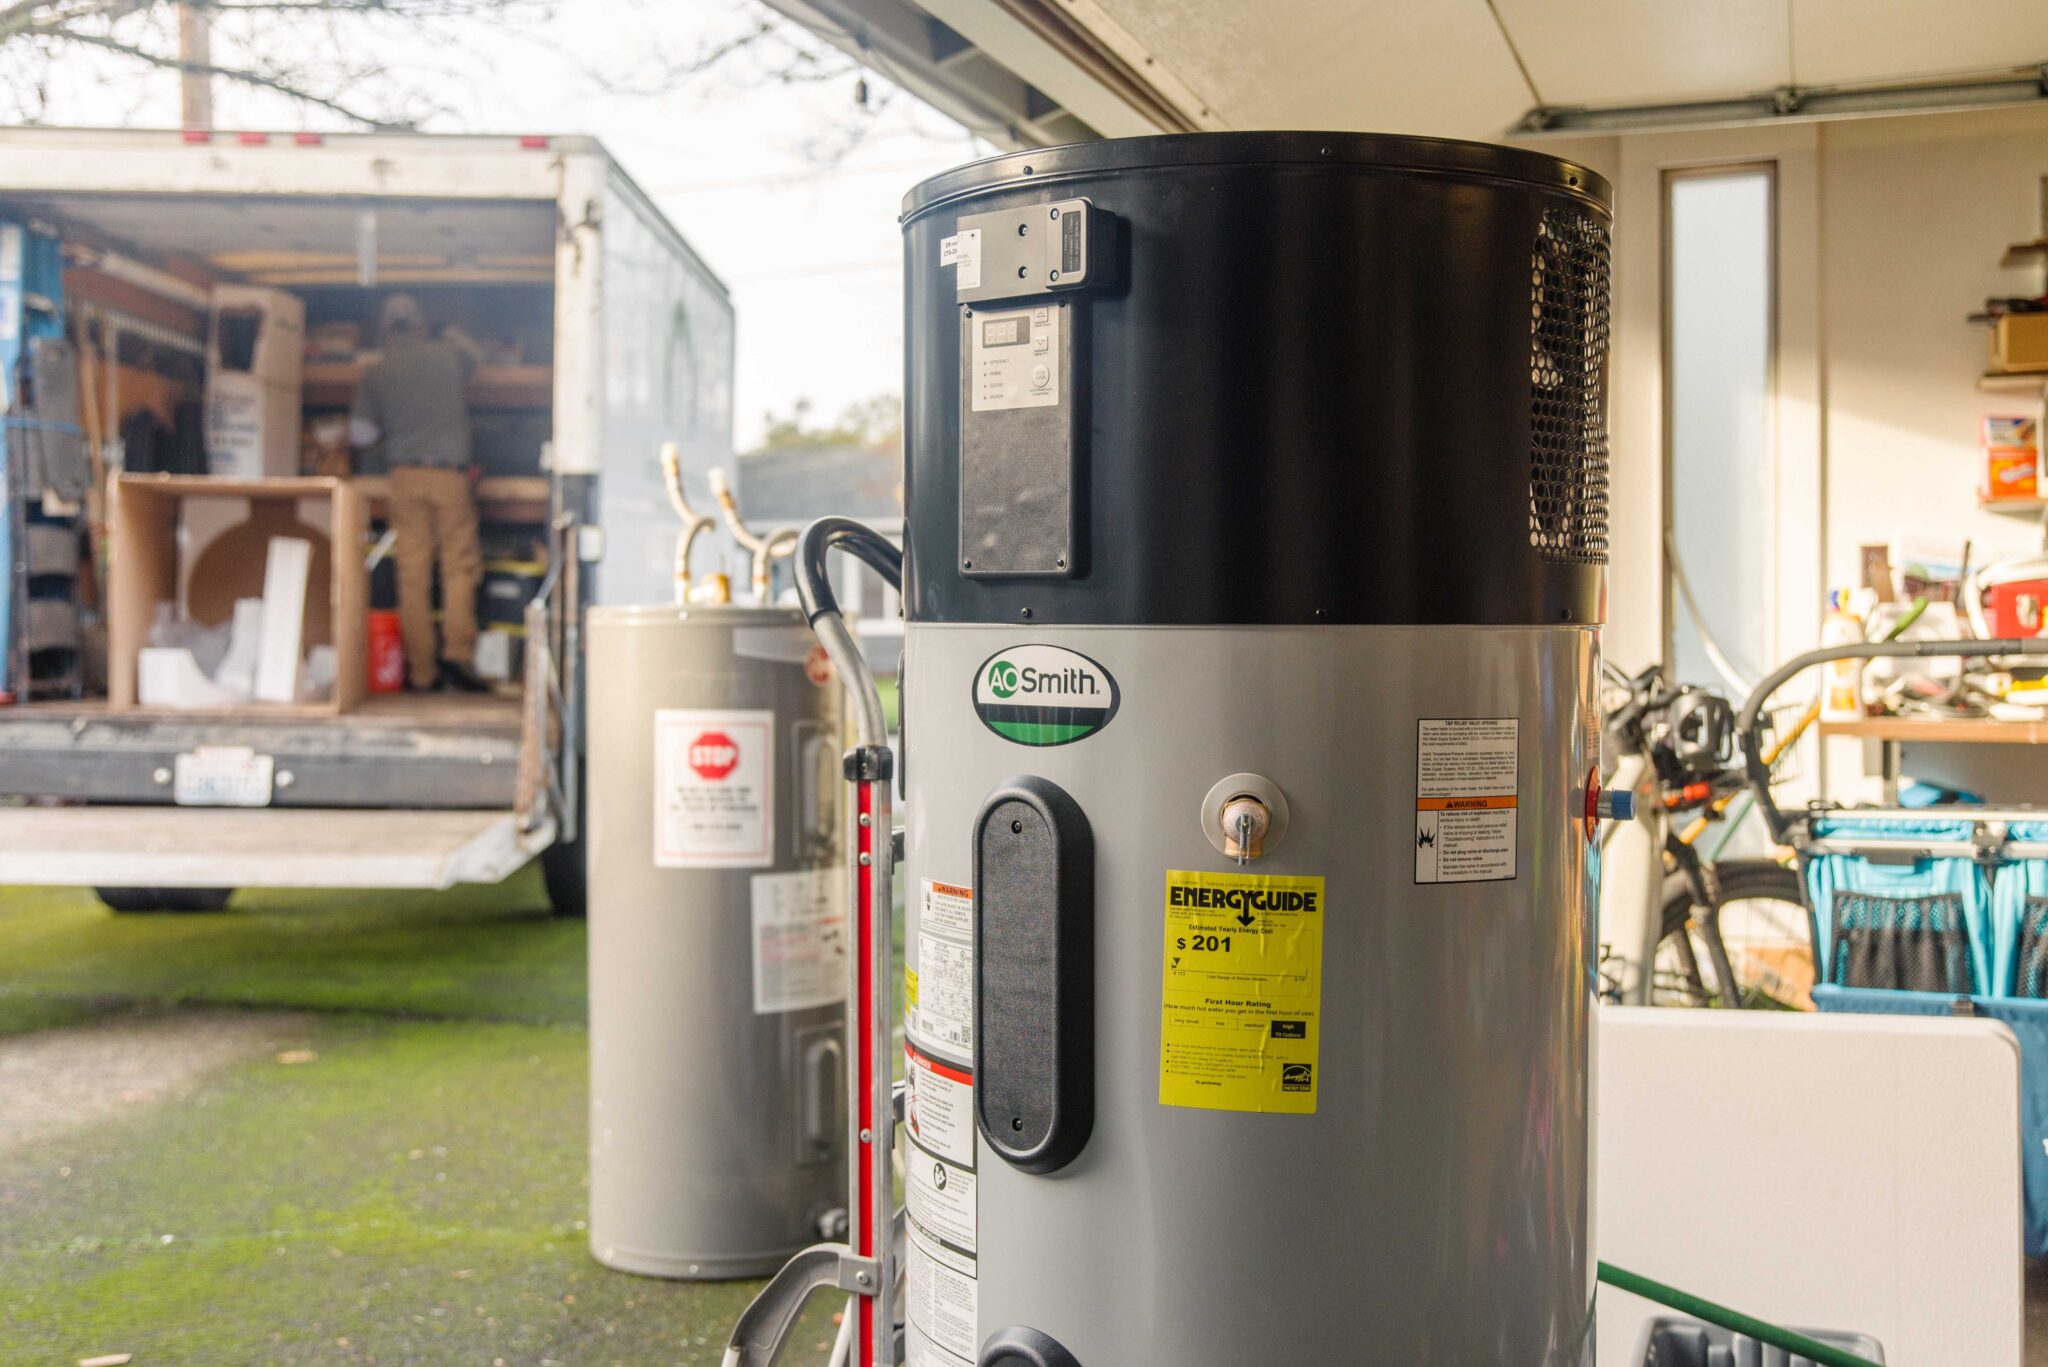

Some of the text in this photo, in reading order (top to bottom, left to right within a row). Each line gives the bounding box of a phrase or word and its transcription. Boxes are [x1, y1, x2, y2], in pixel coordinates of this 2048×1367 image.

[691, 745, 736, 767] STOP
[1454, 800, 1488, 808] WARNING
[940, 884, 969, 898] WARNING
[1170, 886, 1317, 912] ENERGYGUIDE
[1188, 924, 1217, 932] Estimated
[1218, 926, 1238, 934] Yearly
[1238, 927, 1259, 935] Energy
[1177, 934, 1231, 952] $ 201
[1246, 1000, 1272, 1008] Rating
